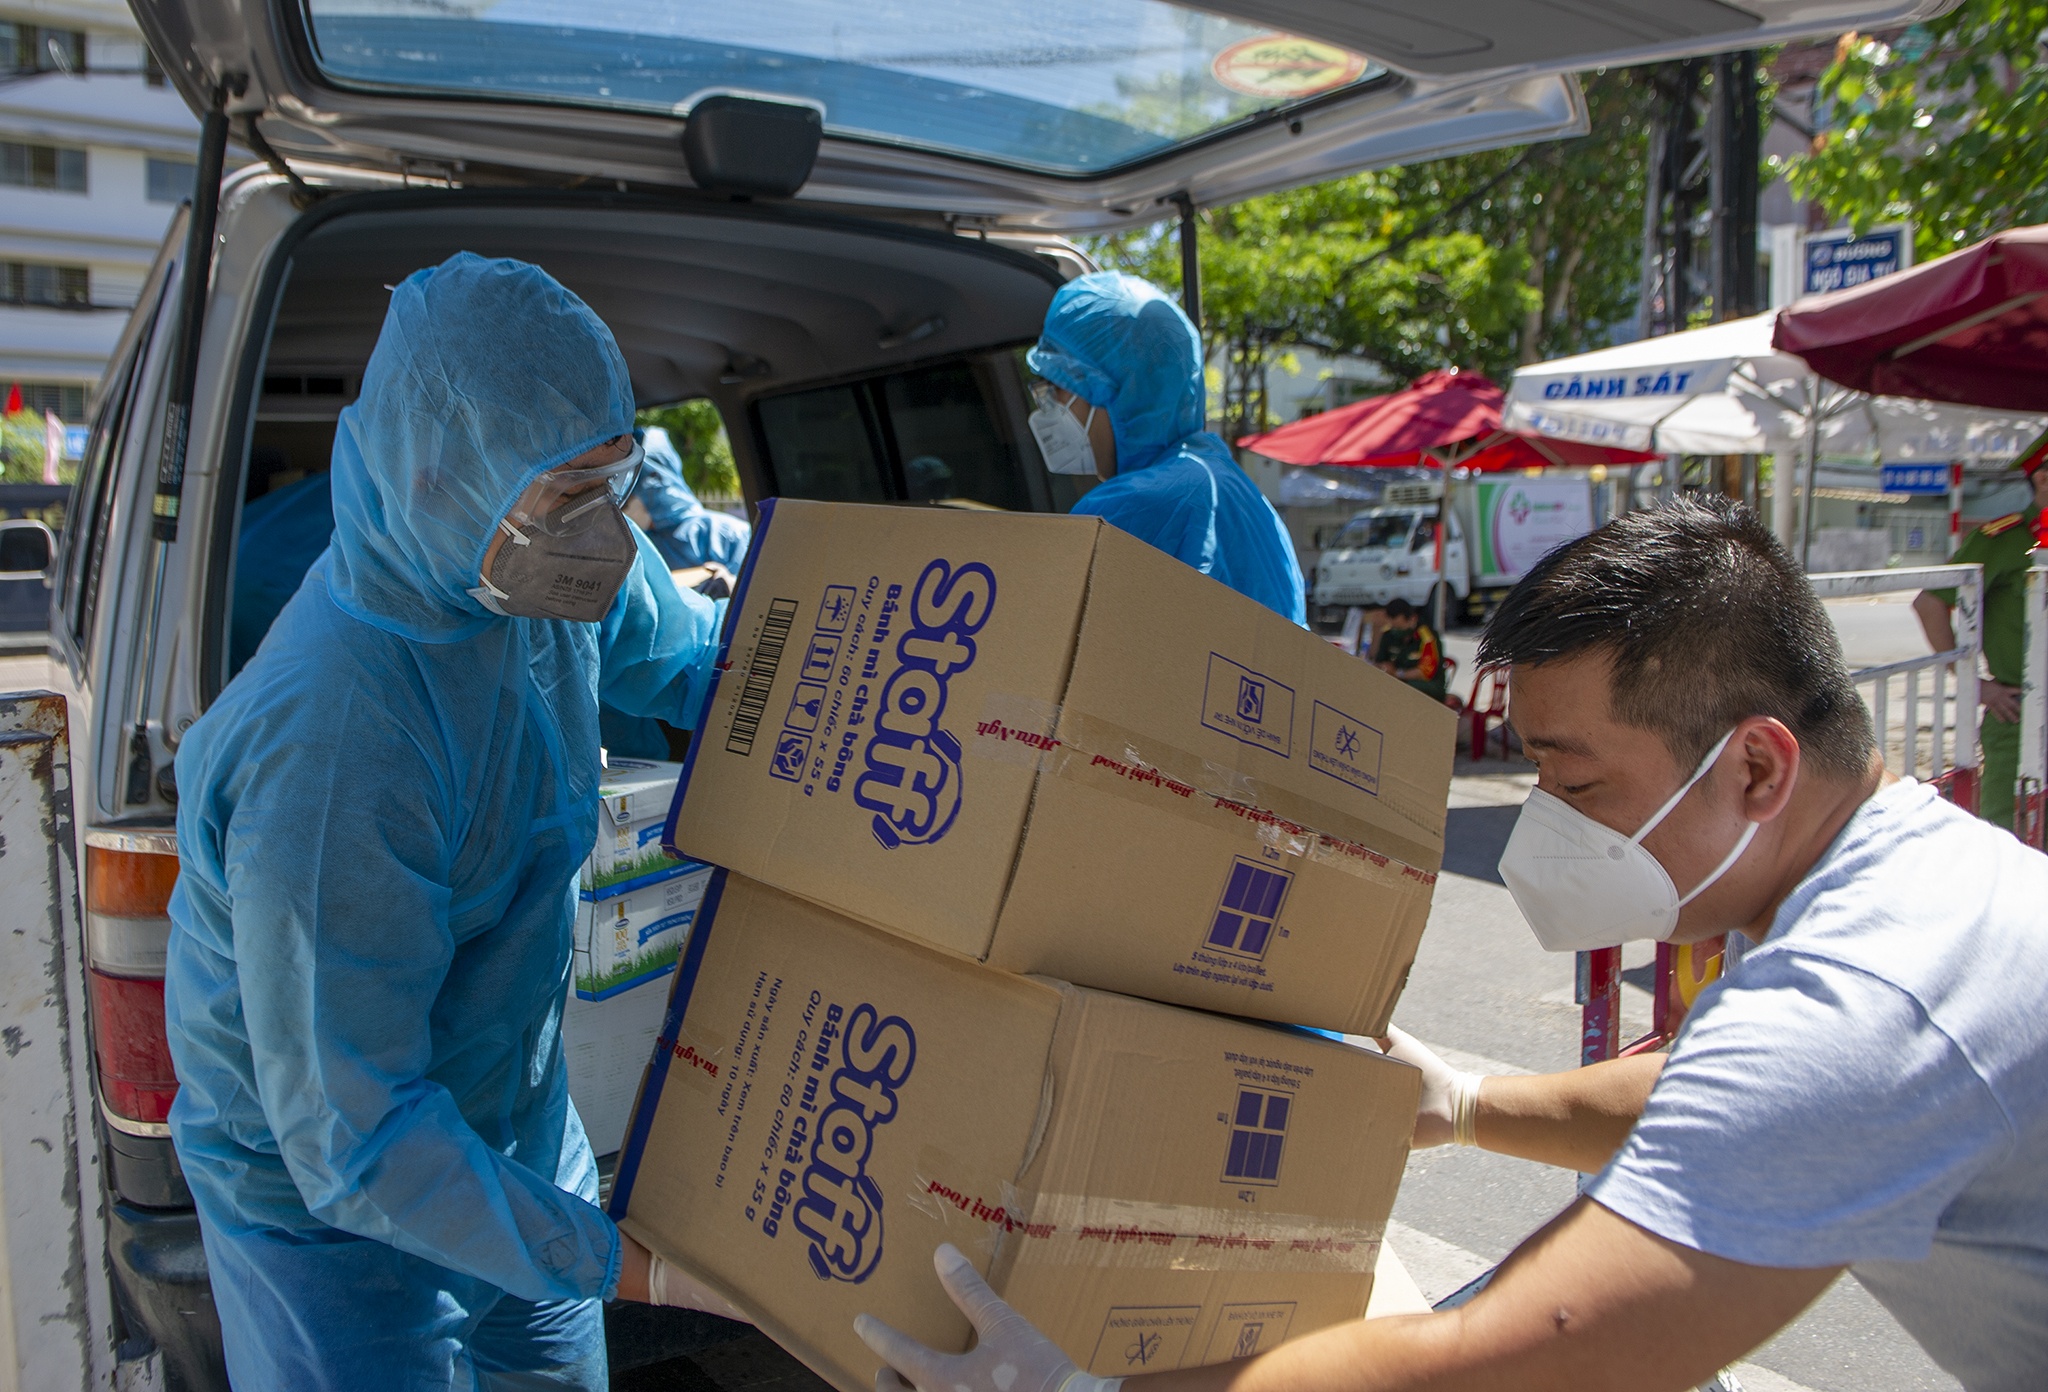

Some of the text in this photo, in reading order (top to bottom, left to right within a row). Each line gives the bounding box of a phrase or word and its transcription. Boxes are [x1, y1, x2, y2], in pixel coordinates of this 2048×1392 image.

[1545, 371, 1692, 399] CẢNH SÁT
[555, 574, 601, 591] 3M 9041
[872, 584, 902, 643] Bánh
[804, 575, 880, 797] Quy cách: 60 chiếc x 55 g
[853, 558, 997, 838] Staff
[847, 684, 868, 726] chà
[826, 732, 858, 793] bông
[1090, 755, 1127, 776] Food
[753, 971, 768, 998] Hạn
[764, 978, 783, 1013] Ngày
[758, 1016, 770, 1041] sản
[811, 1003, 844, 1071] Bánh
[729, 1066, 739, 1081] 10
[717, 1084, 733, 1116] ngày
[737, 1081, 752, 1111] Xem
[745, 989, 822, 1222] Quy cách: 60 chiếc x 55 g
[727, 1115, 742, 1143] trên
[784, 1116, 807, 1165] chà
[792, 1003, 917, 1275] Staff
[720, 1145, 733, 1172] bao
[714, 1174, 725, 1189] bì
[927, 1180, 971, 1211] Food
[762, 1169, 797, 1239] bông
